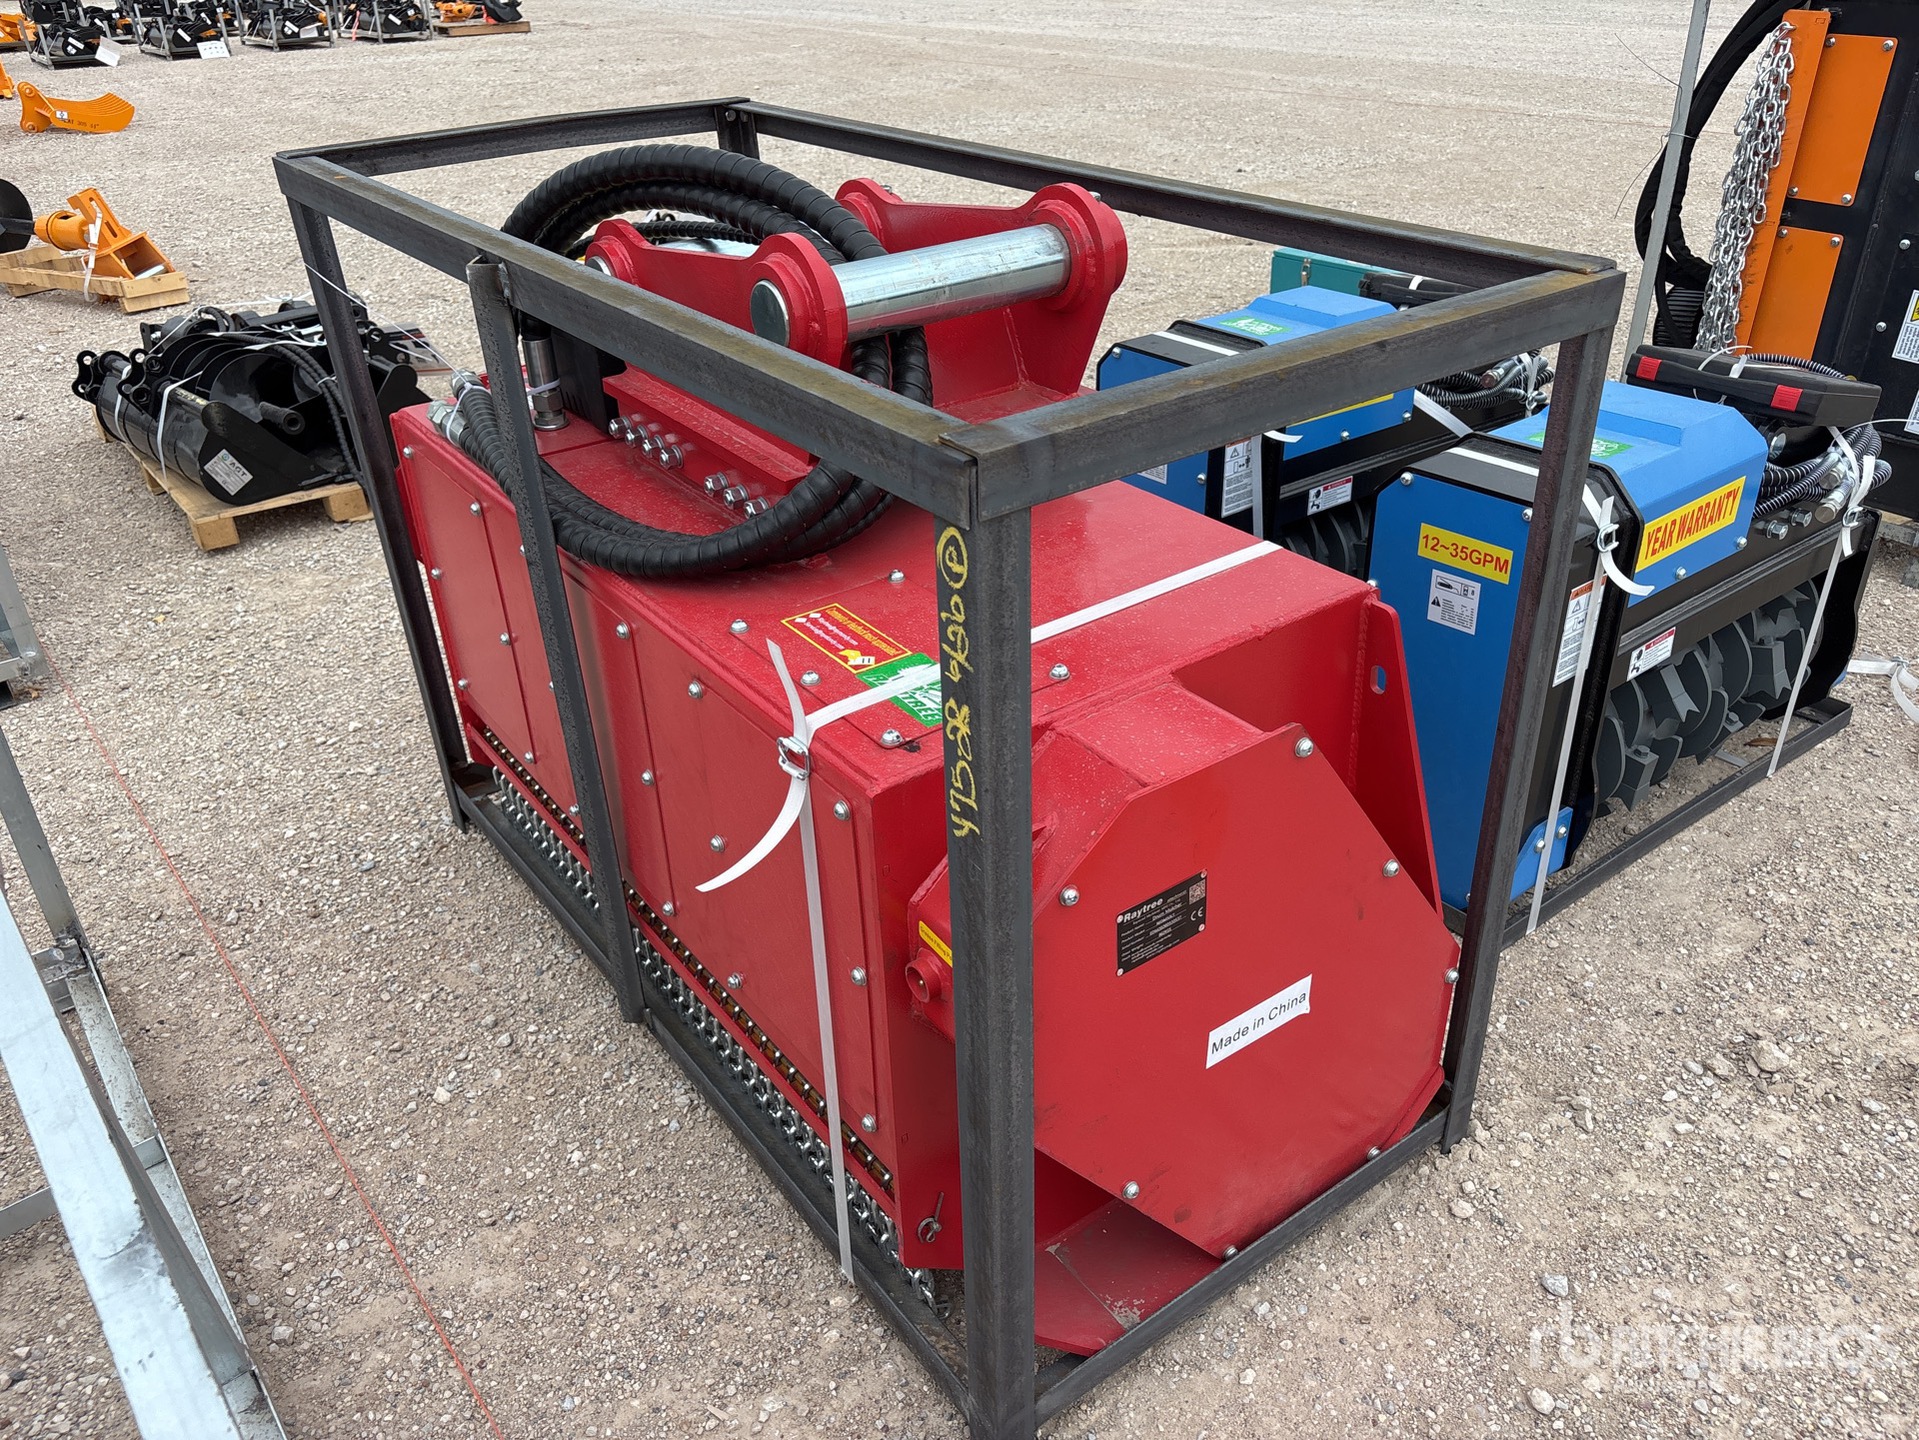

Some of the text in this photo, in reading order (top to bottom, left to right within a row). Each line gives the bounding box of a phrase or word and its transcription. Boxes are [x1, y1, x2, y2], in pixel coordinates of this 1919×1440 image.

[229, 462, 248, 477] AGT
[1645, 486, 1740, 560] YEAR WARRANTY
[1422, 534, 1510, 575] 12~35GPM
[1123, 897, 1164, 923] Raytree
[1211, 991, 1306, 1054] Made in China
